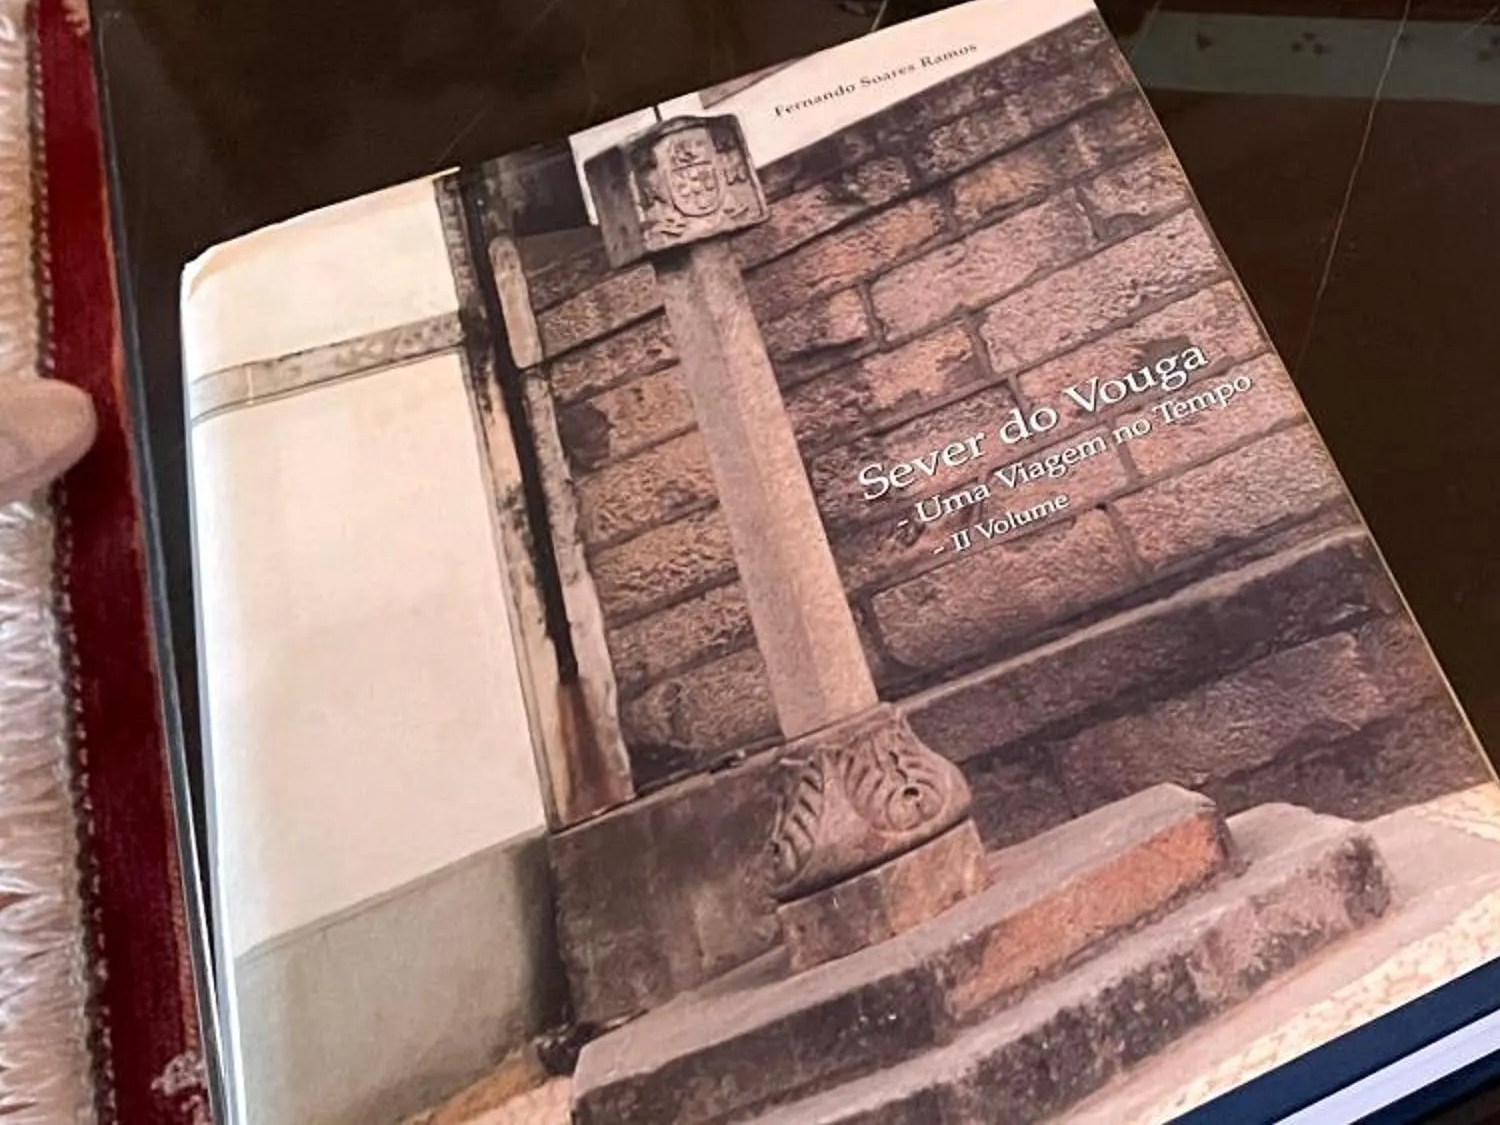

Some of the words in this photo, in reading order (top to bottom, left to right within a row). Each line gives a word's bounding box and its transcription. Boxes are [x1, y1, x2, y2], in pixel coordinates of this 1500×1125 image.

[773, 83, 856, 118] Fernando
[859, 63, 917, 88] Soares
[920, 42, 978, 69] Ramos
[857, 430, 986, 501] Sever
[999, 408, 1060, 446] do
[1063, 343, 1209, 415] Vouga
[914, 483, 992, 524] Uma
[994, 434, 1107, 488] Viagem
[1112, 417, 1153, 445] no
[1151, 374, 1253, 425] Tempo
[950, 528, 972, 552] II
[974, 493, 1070, 540] Volume
